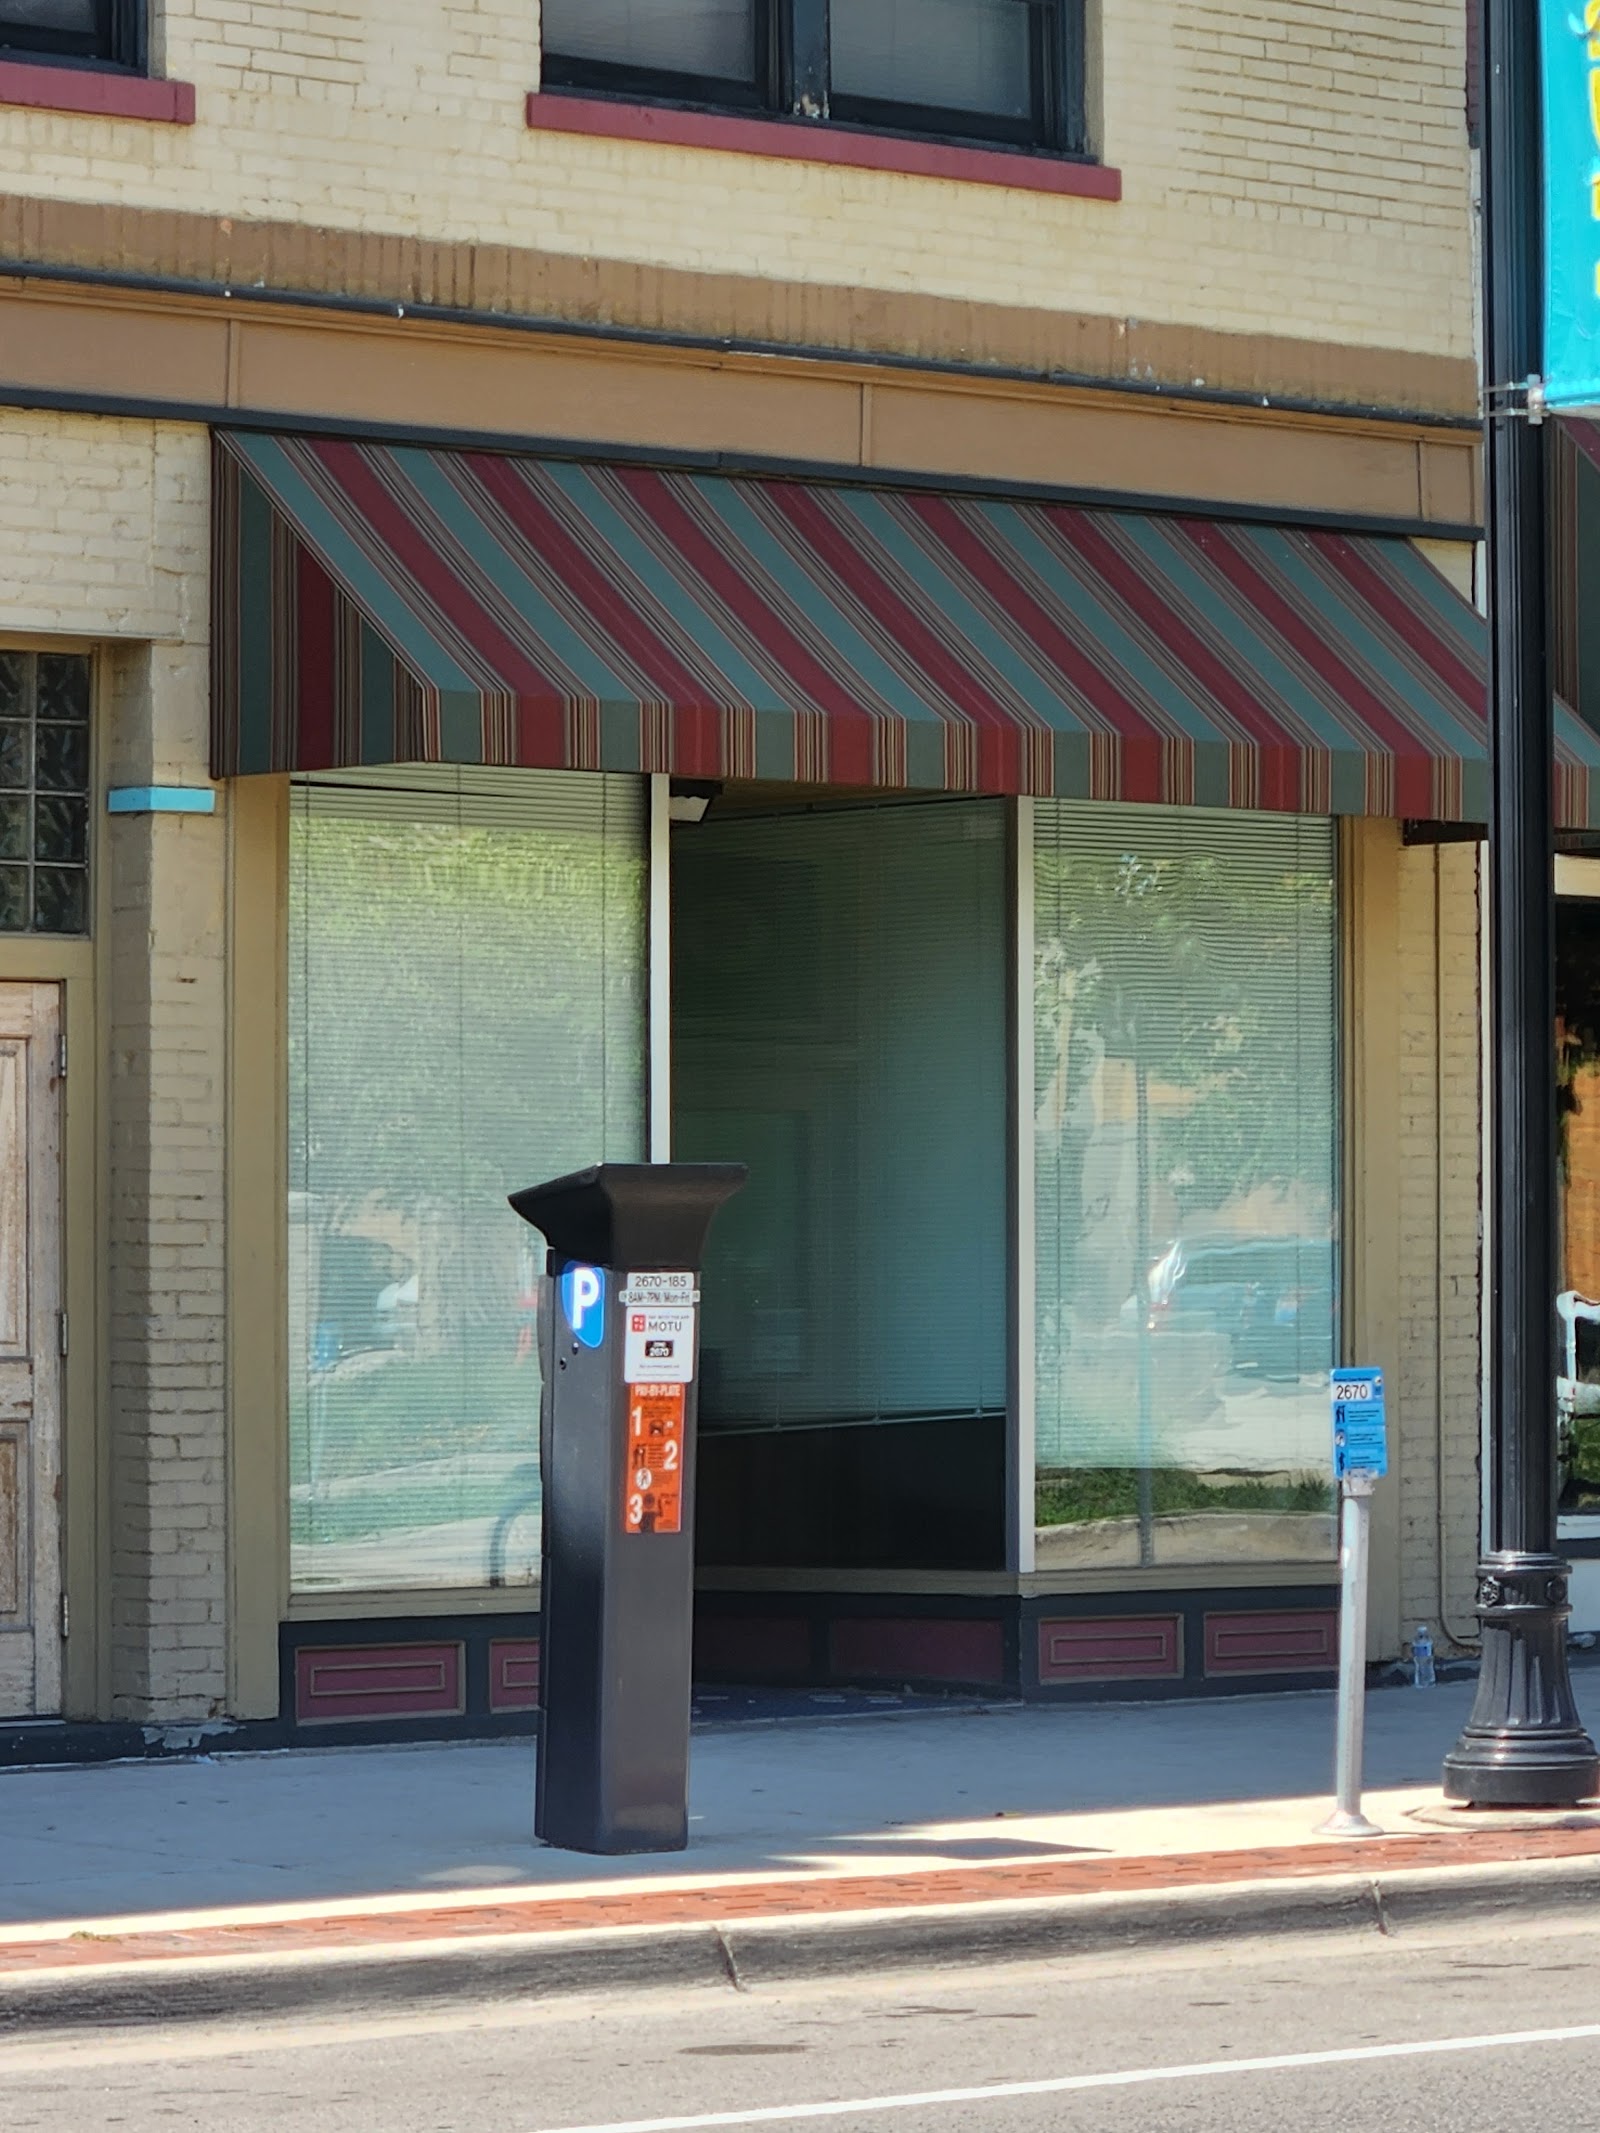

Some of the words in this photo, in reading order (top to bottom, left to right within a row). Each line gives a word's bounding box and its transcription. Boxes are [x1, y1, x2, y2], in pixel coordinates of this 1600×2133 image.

[635, 1276, 687, 1287] 2670-185
[573, 1268, 599, 1329] P
[648, 1321, 682, 1332] MOTU
[1336, 1384, 1368, 1400] 2670
[632, 1405, 643, 1436] 1
[663, 1439, 678, 1471] 2
[629, 1493, 643, 1525] 3
